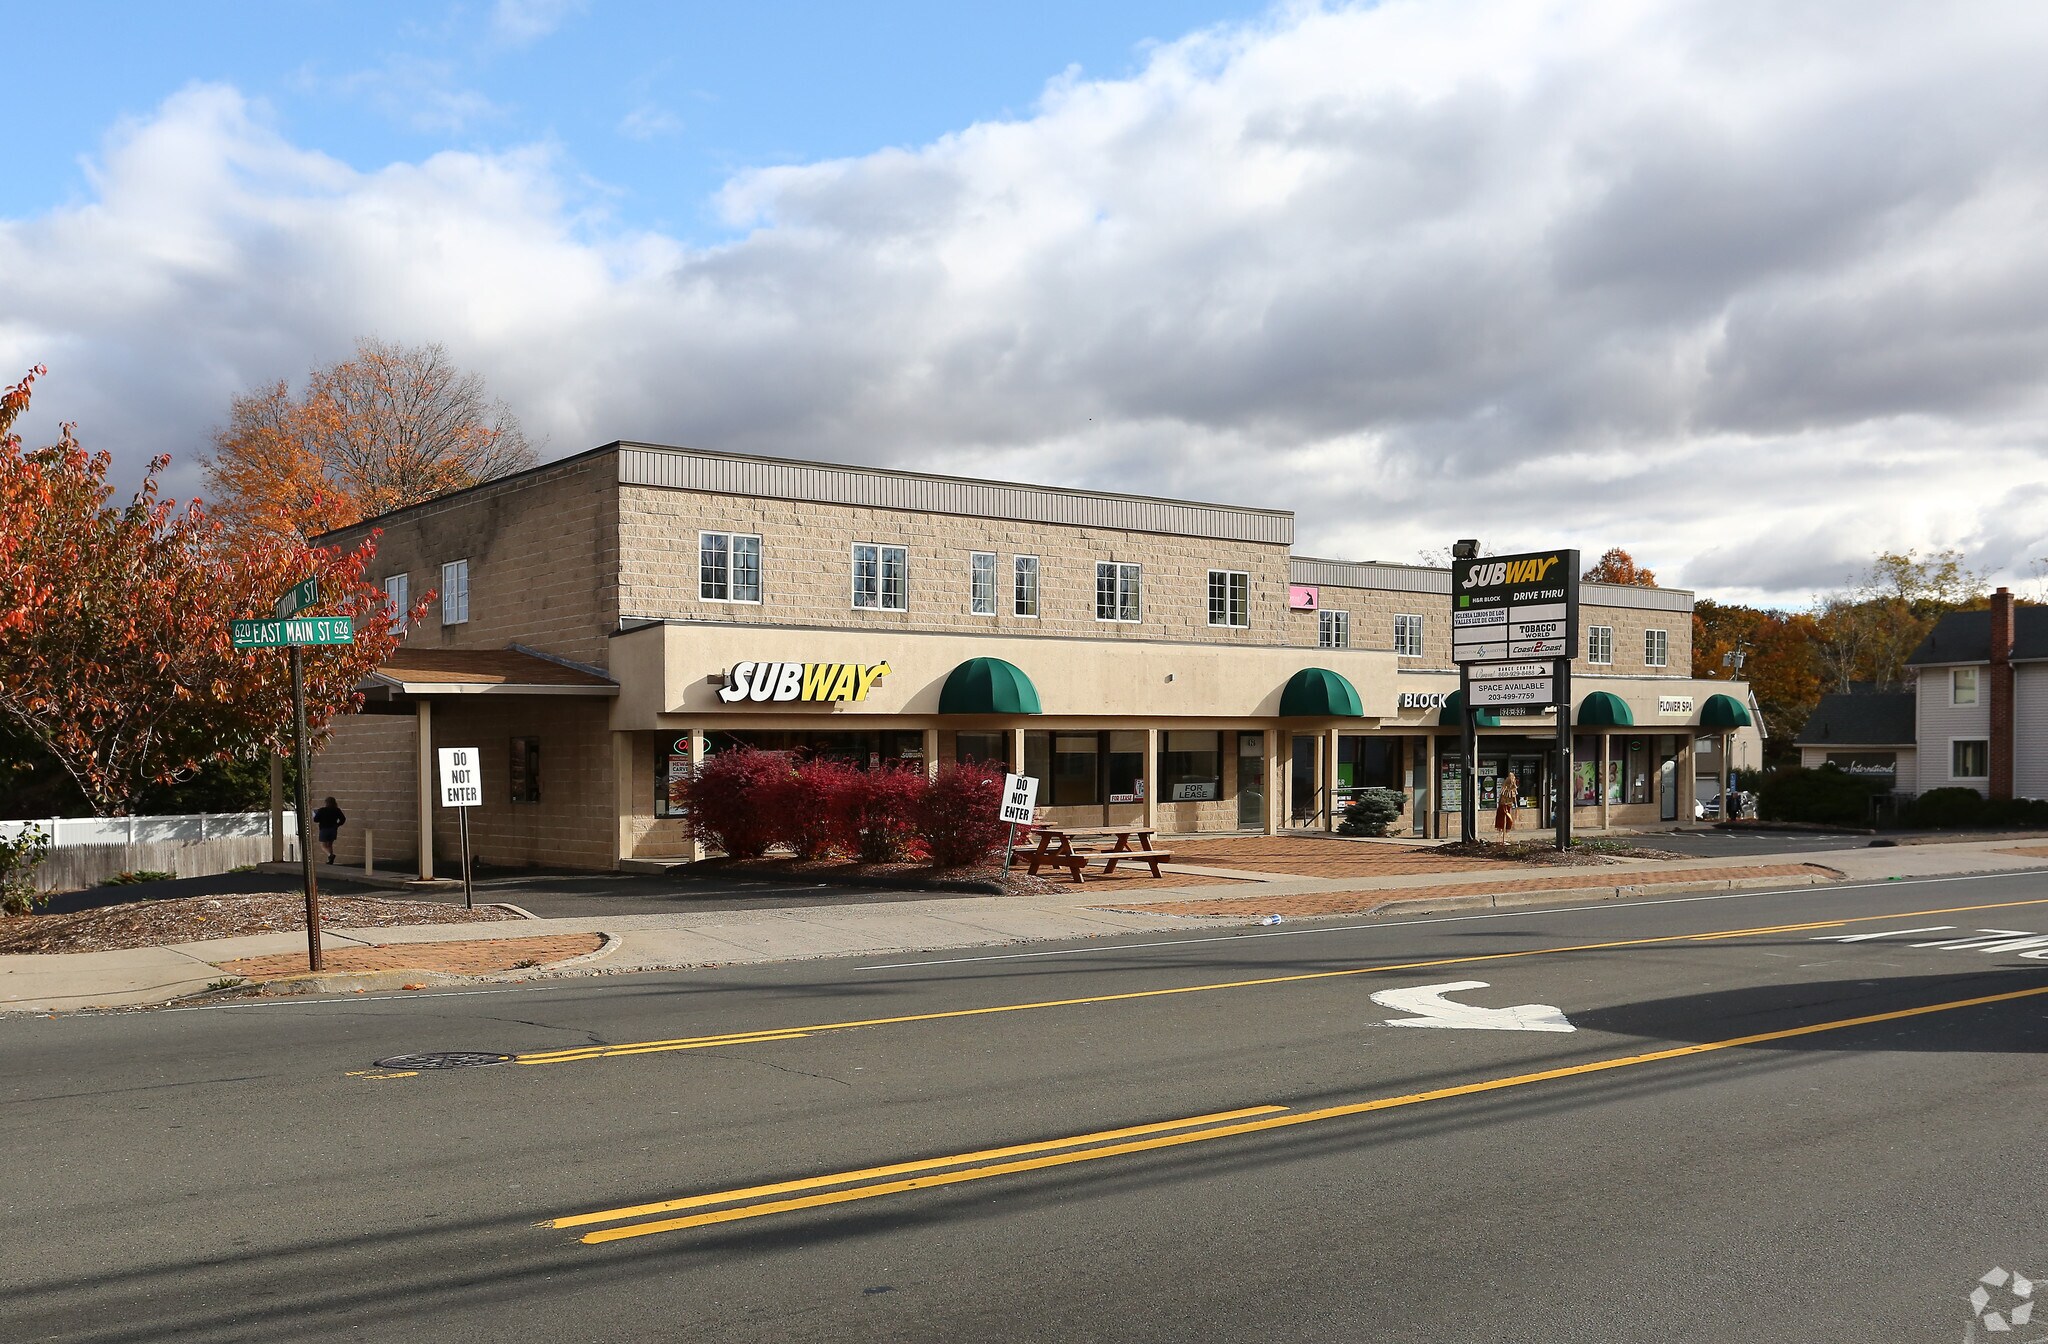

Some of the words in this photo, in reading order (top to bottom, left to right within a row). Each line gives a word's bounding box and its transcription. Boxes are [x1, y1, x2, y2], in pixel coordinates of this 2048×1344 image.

[1461, 555, 1559, 589] SUBWAY
[304, 580, 315, 603] ST
[1513, 591, 1539, 601] DRIVE
[1540, 589, 1564, 598] THRU
[235, 623, 251, 637] 620
[253, 622, 281, 643] EAST
[285, 622, 314, 642] MAIN
[318, 621, 331, 641] ST
[334, 621, 349, 635] 626
[1520, 623, 1557, 633] TOBACCO
[718, 660, 892, 704] SUBWAY
[1478, 684, 1503, 692] SPACE
[1504, 683, 1545, 691] AVAILABLE
[1404, 693, 1447, 708] BLOCK
[1488, 692, 1535, 701] 203-499-7759
[1659, 701, 1681, 712] FLOWER
[1682, 701, 1692, 712] SPA
[453, 752, 467, 766] DO
[451, 770, 471, 784] NOT
[1015, 778, 1028, 791] DO
[447, 787, 478, 802] ENTER
[1011, 792, 1029, 806] NOT
[1179, 791, 1208, 799] LEASE
[1004, 805, 1030, 821] ENTER
